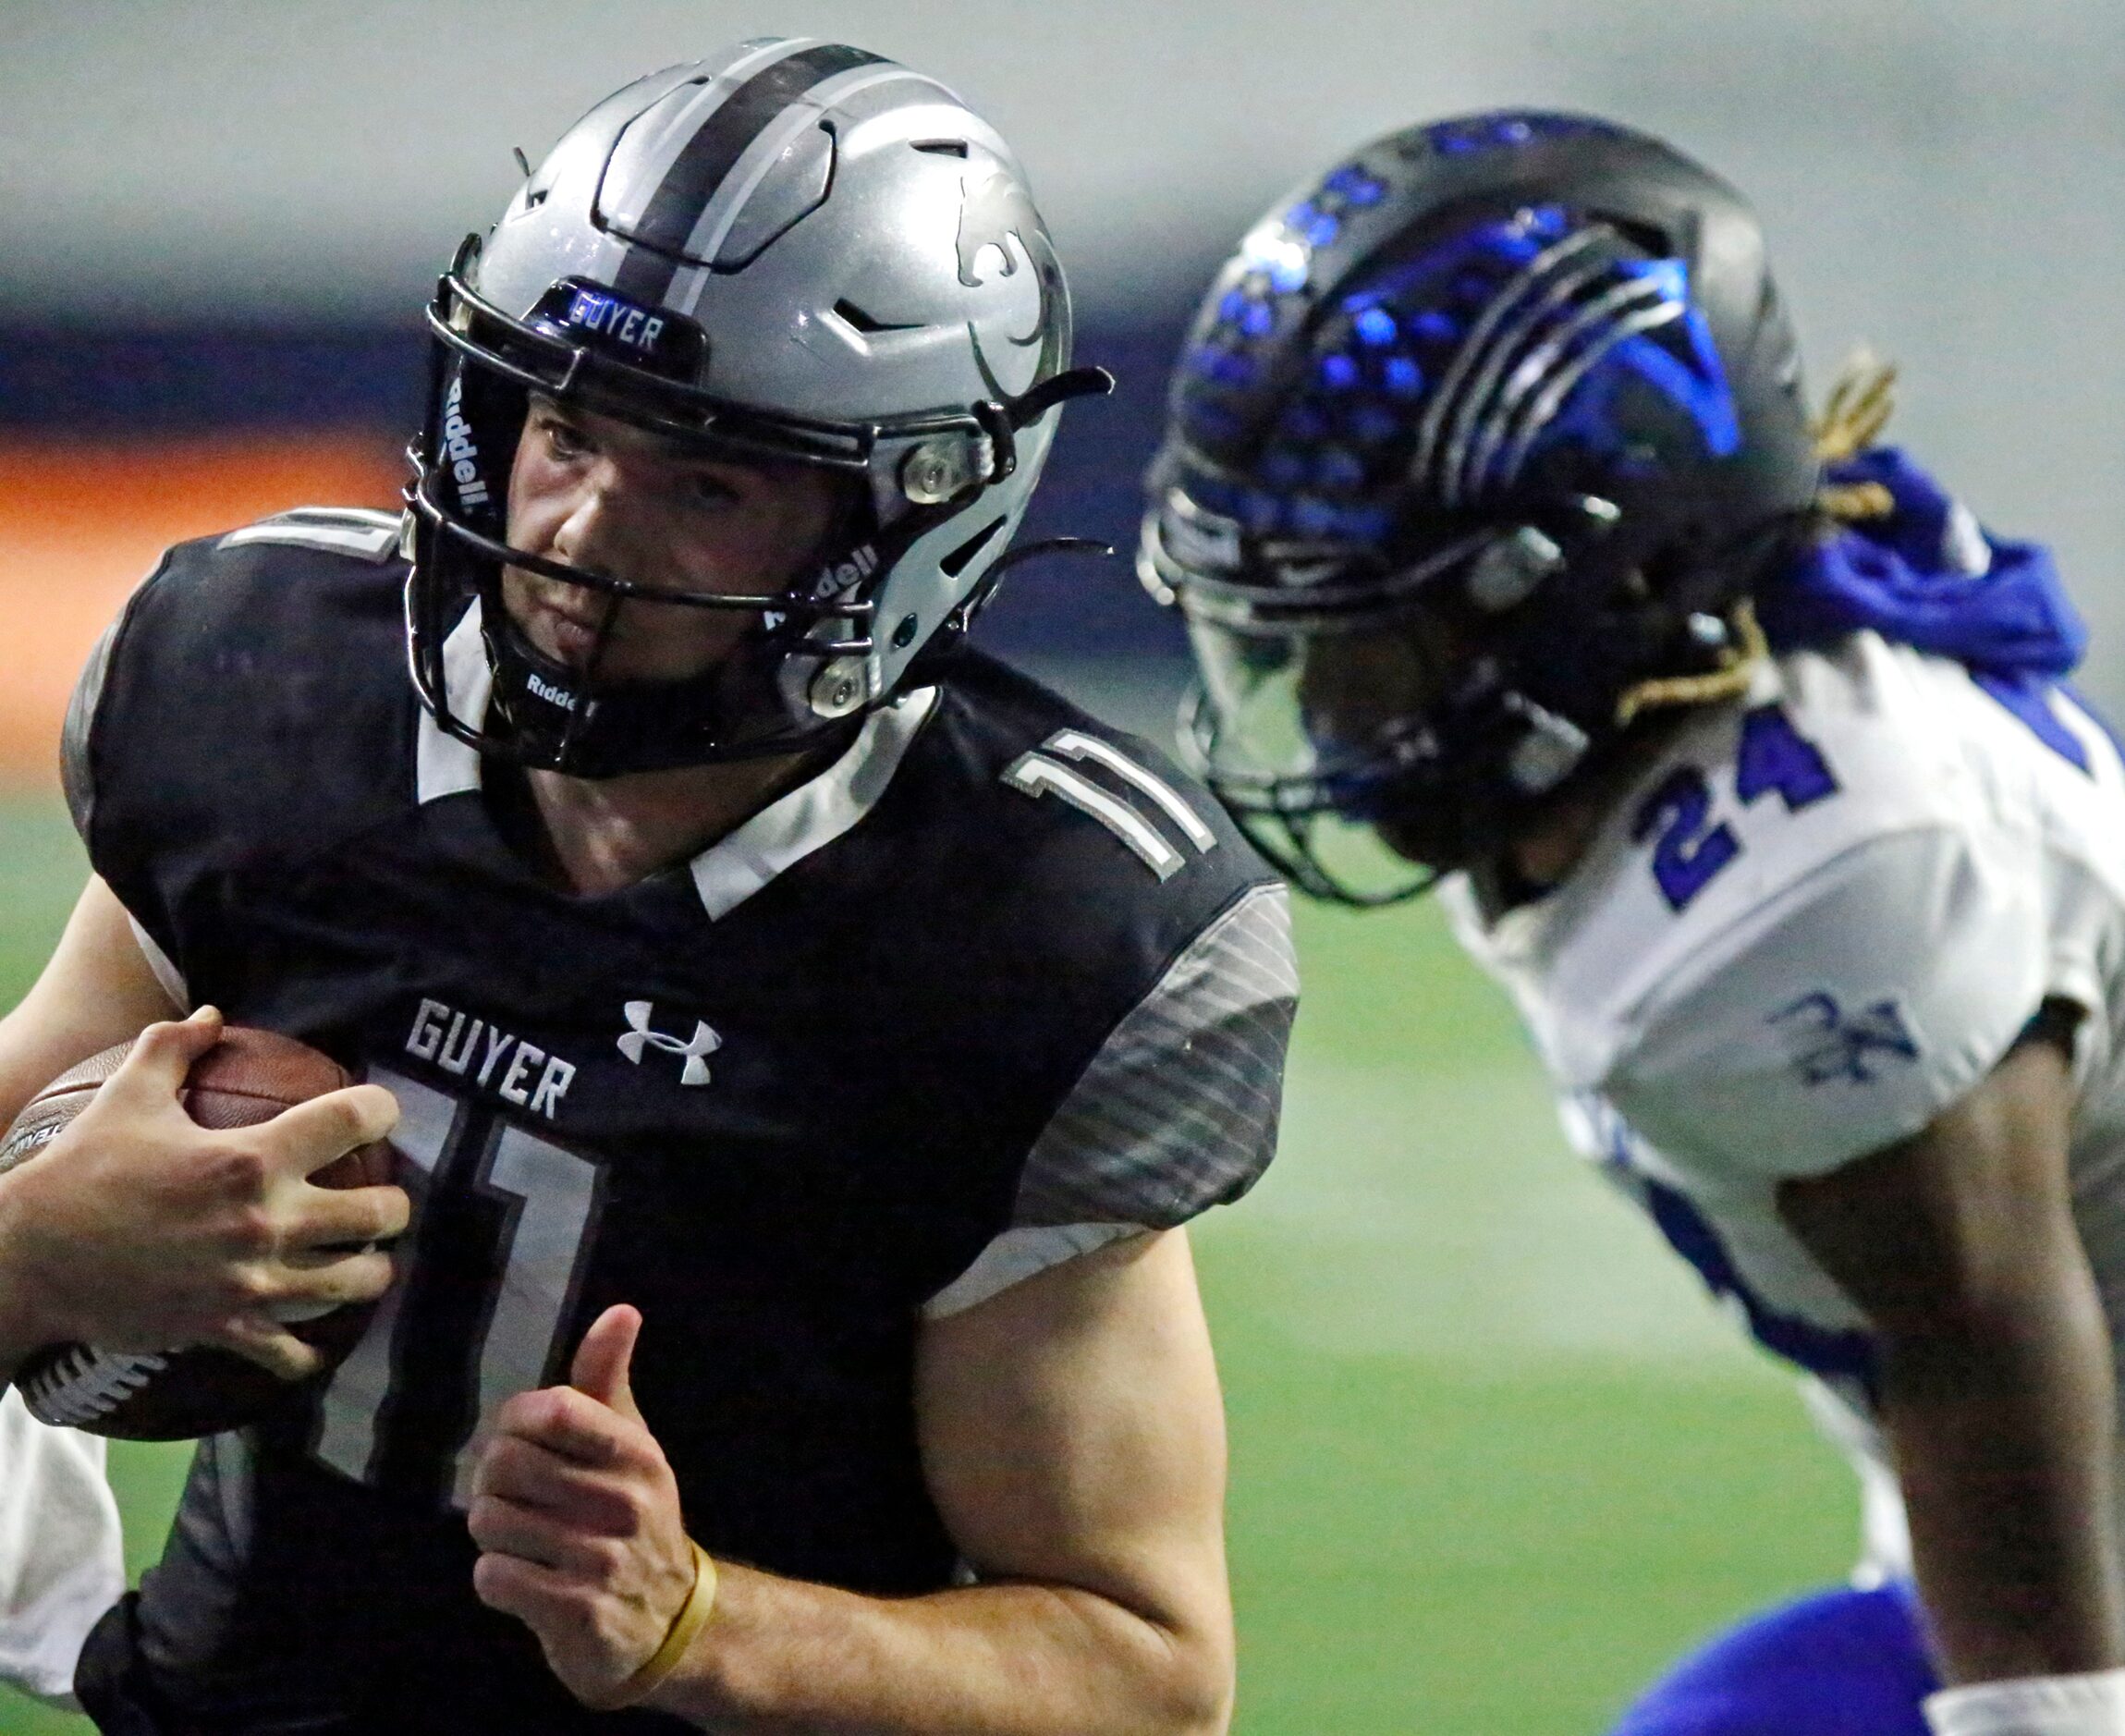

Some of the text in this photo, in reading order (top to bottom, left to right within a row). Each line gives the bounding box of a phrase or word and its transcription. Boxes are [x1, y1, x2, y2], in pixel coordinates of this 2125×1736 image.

[569, 290, 664, 349] GUYER
[446, 376, 488, 505] Riddell
[526, 673, 577, 712] Ridde
[999, 727, 1217, 883] 11
[1630, 704, 1843, 914] 24
[405, 997, 577, 1120] GUYER
